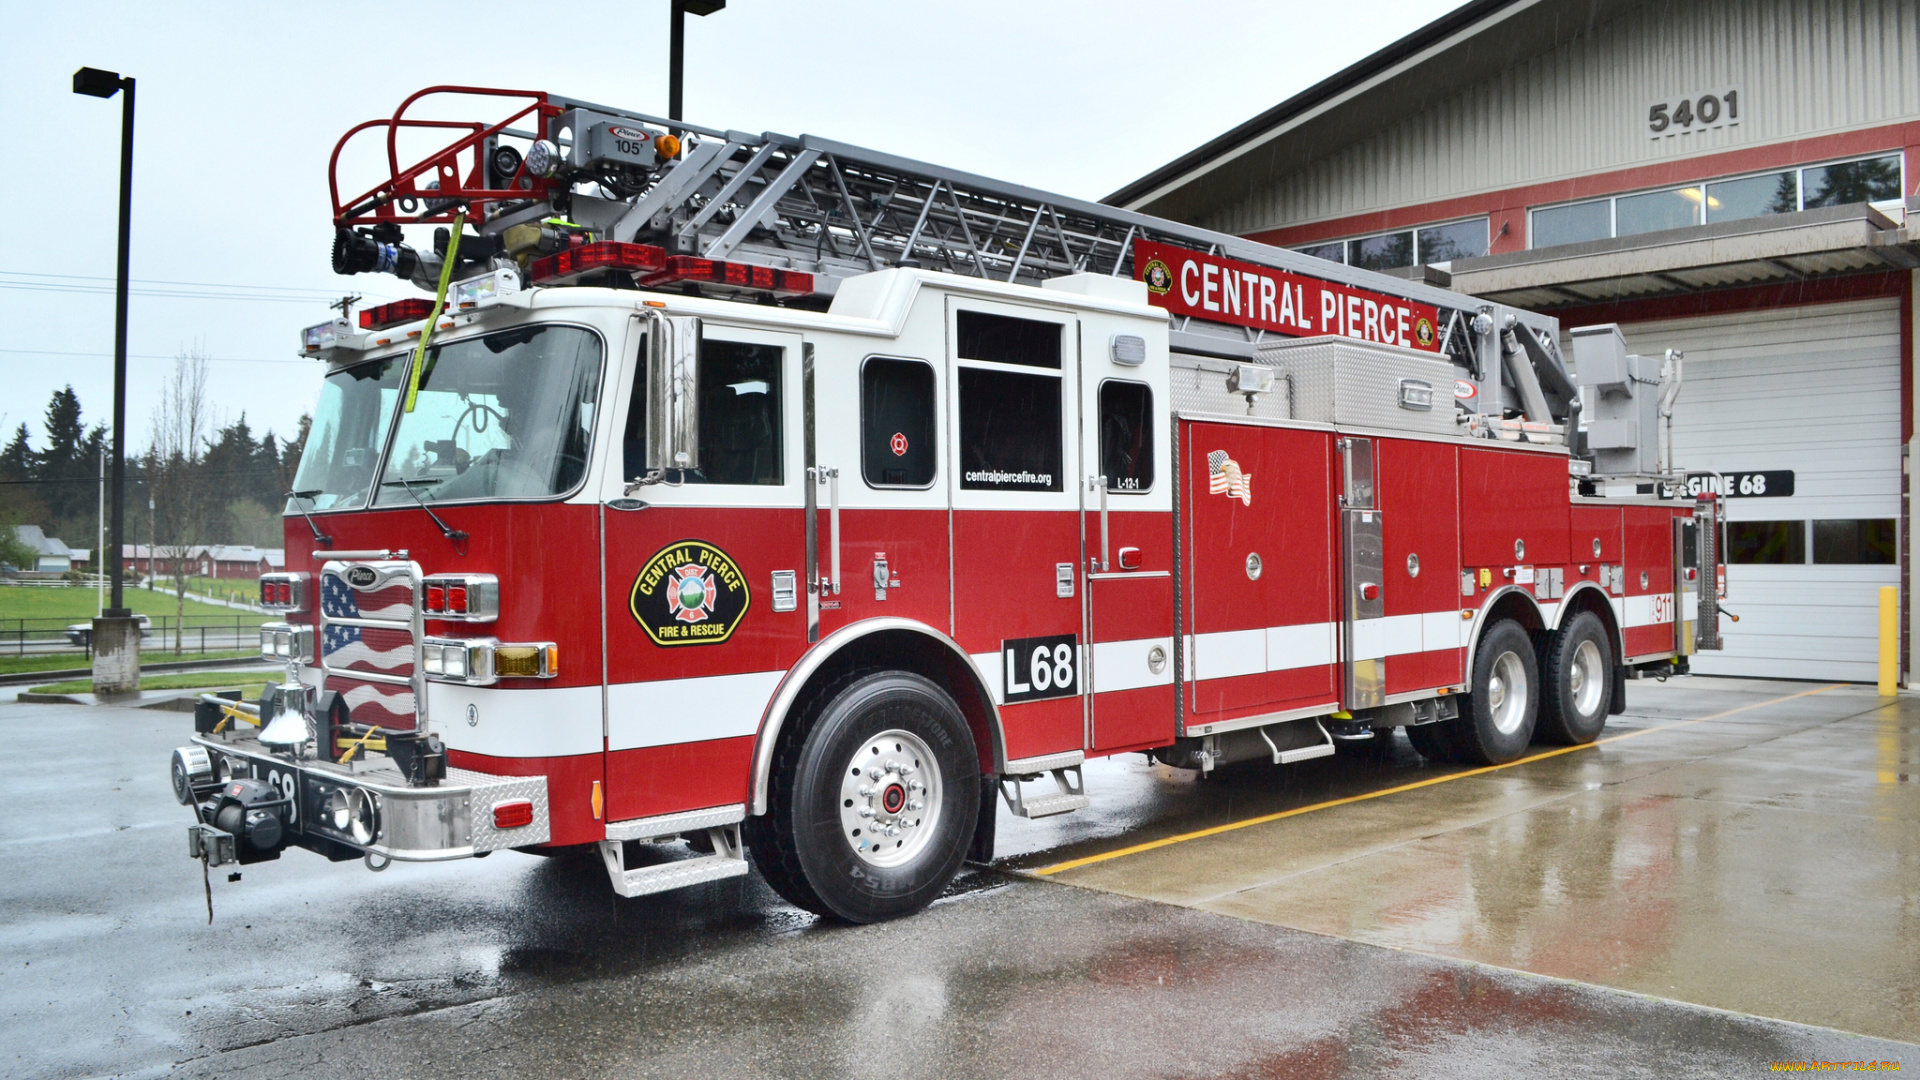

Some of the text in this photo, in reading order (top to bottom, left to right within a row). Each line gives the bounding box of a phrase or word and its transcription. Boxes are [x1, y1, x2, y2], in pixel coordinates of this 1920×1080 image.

[1648, 90, 1737, 132] 5401
[617, 127, 641, 138] Pierce
[615, 140, 643, 155] 105'
[1180, 259, 1311, 330] CENTRAL
[1320, 289, 1412, 348] PIERCE
[965, 470, 1052, 486] centralpiercefire.org
[1117, 478, 1139, 489] L-12-1
[1739, 474, 1766, 495] 68
[640, 548, 741, 595] CENTRAL PIERCE
[689, 611, 695, 619] 6
[1656, 595, 1672, 622] 911
[659, 624, 724, 638] FIRE & RESCUE
[1006, 643, 1073, 694] L68
